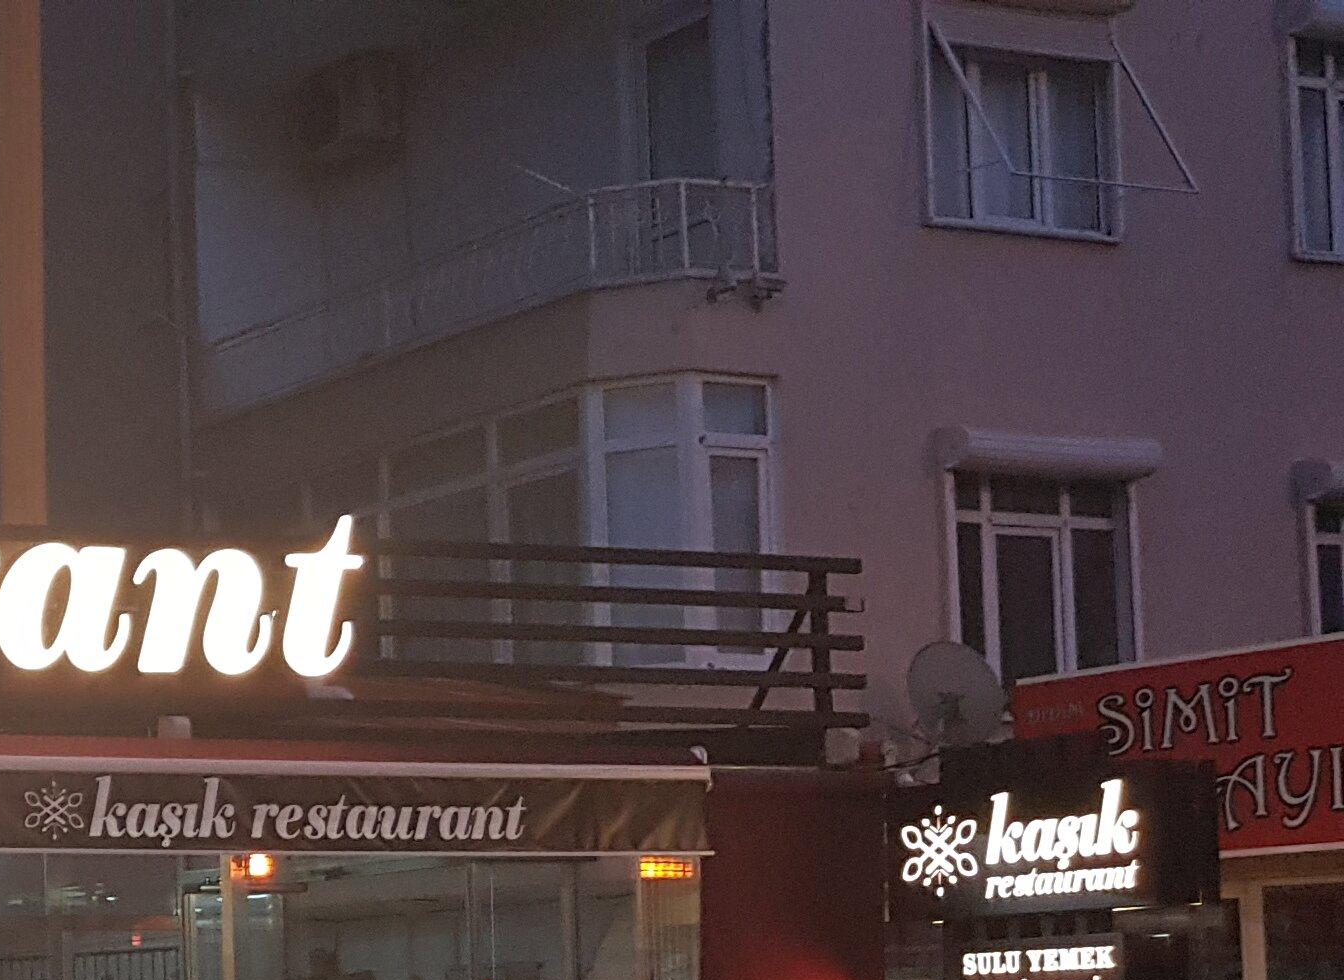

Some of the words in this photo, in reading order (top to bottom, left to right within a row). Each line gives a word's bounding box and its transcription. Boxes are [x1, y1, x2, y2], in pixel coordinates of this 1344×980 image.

[1097, 667, 1293, 756] SİMİT
[88, 775, 236, 848] kaşık
[250, 794, 527, 841] restaurant
[985, 779, 1140, 870] kaşık
[984, 859, 1141, 900] restaurant
[962, 950, 1022, 976] SULU
[1025, 945, 1116, 973] YEMEK
